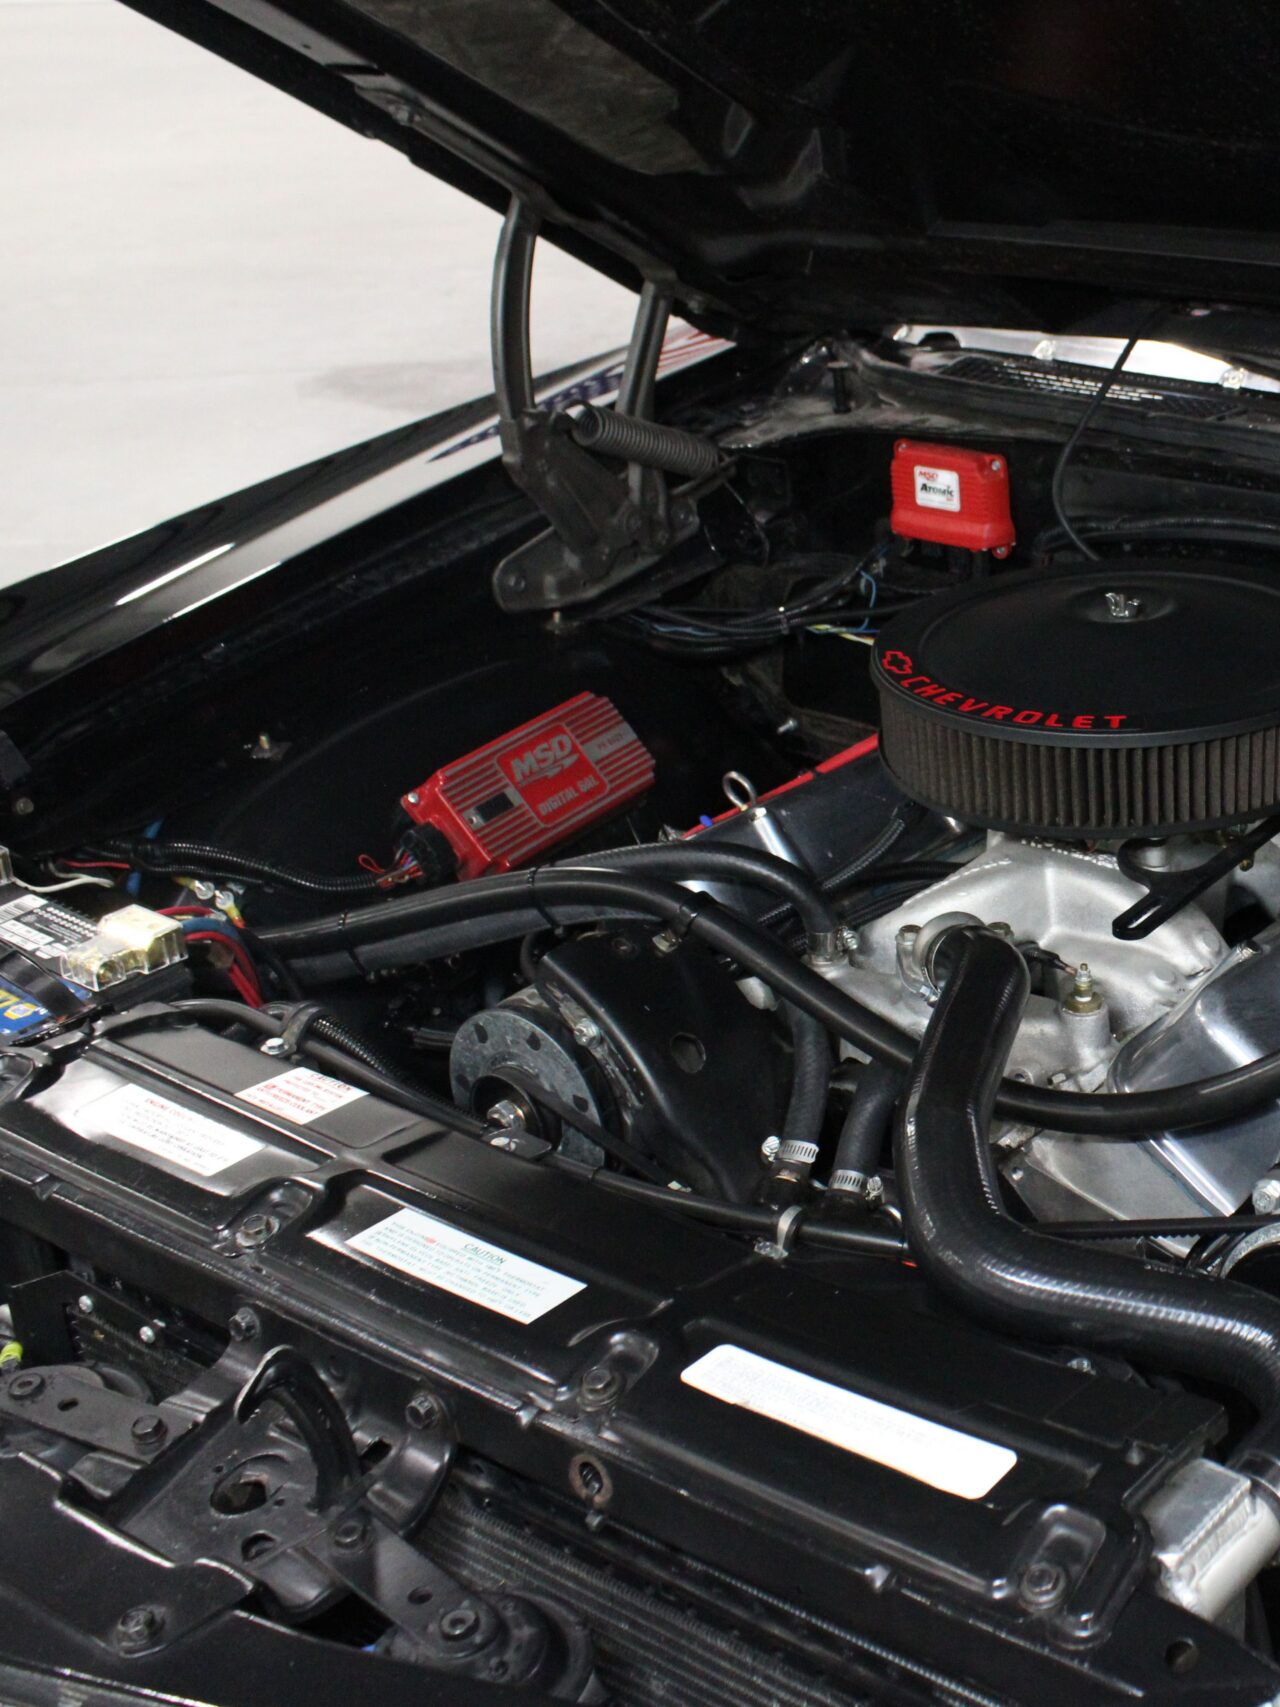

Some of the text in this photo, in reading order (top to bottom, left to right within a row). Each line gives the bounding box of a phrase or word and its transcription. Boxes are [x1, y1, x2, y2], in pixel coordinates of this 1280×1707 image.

[900, 675, 1127, 729] CHEVROLET
[511, 734, 572, 781] MSD
[539, 787, 579, 816] DIGITAL
[463, 1242, 507, 1264] CAUTION
